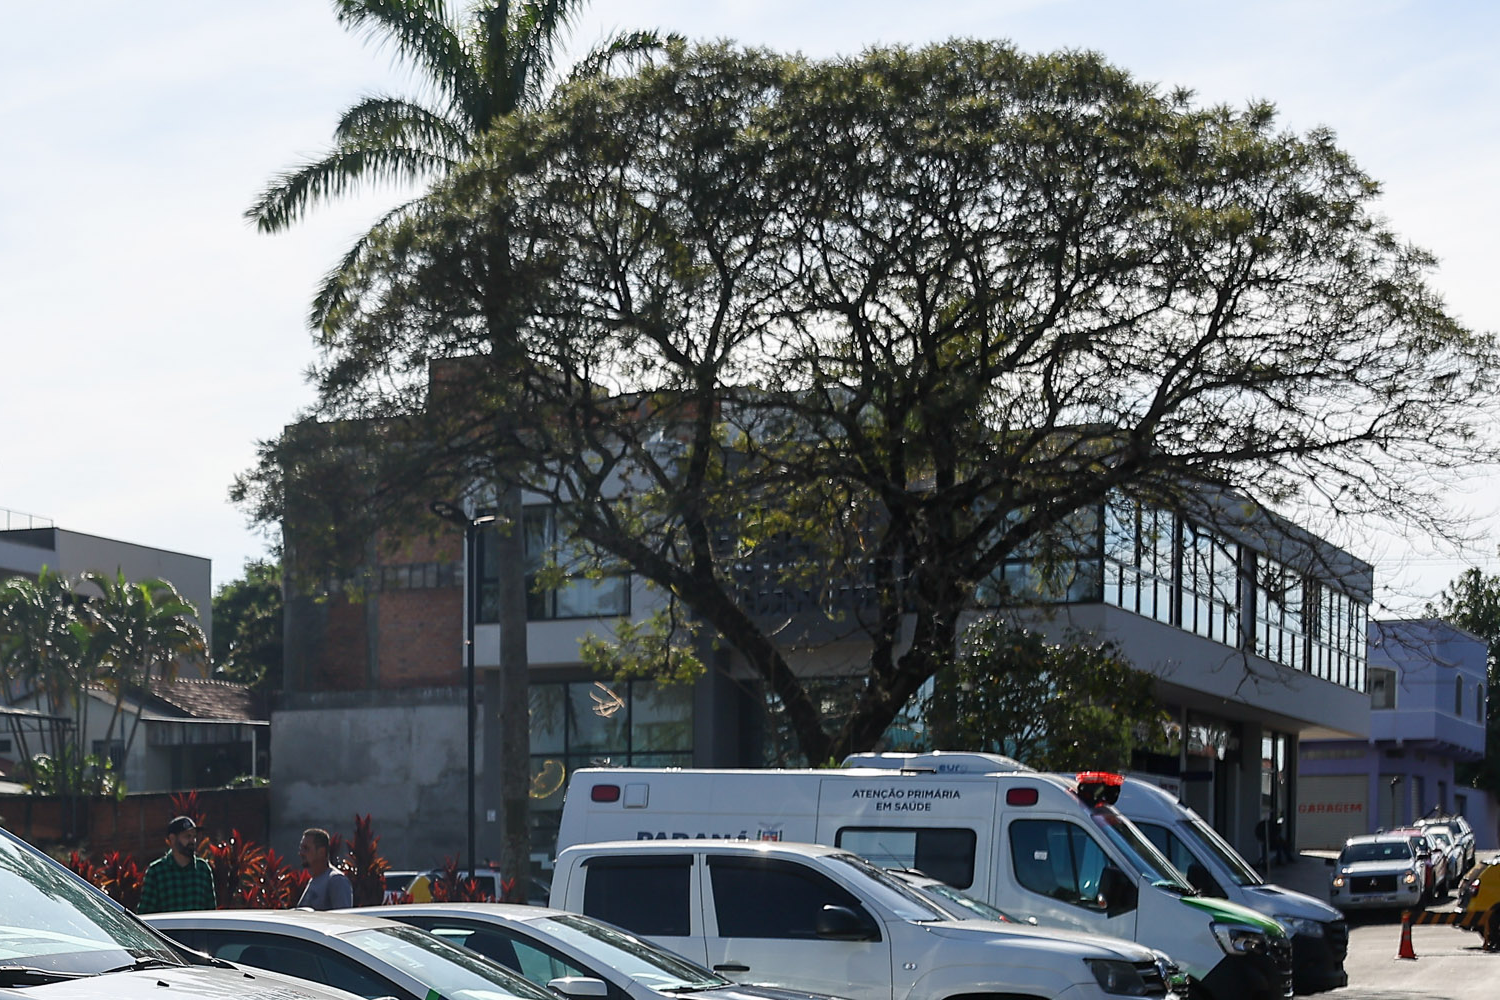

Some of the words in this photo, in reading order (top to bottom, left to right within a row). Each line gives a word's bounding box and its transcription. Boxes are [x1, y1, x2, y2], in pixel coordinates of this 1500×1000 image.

[852, 788, 905, 800] ATENÇÃO
[907, 788, 961, 800] PRIMÁRIA
[876, 802, 892, 812] EM
[894, 801, 932, 812] SAÚDE
[1298, 802, 1363, 814] GARAGEM
